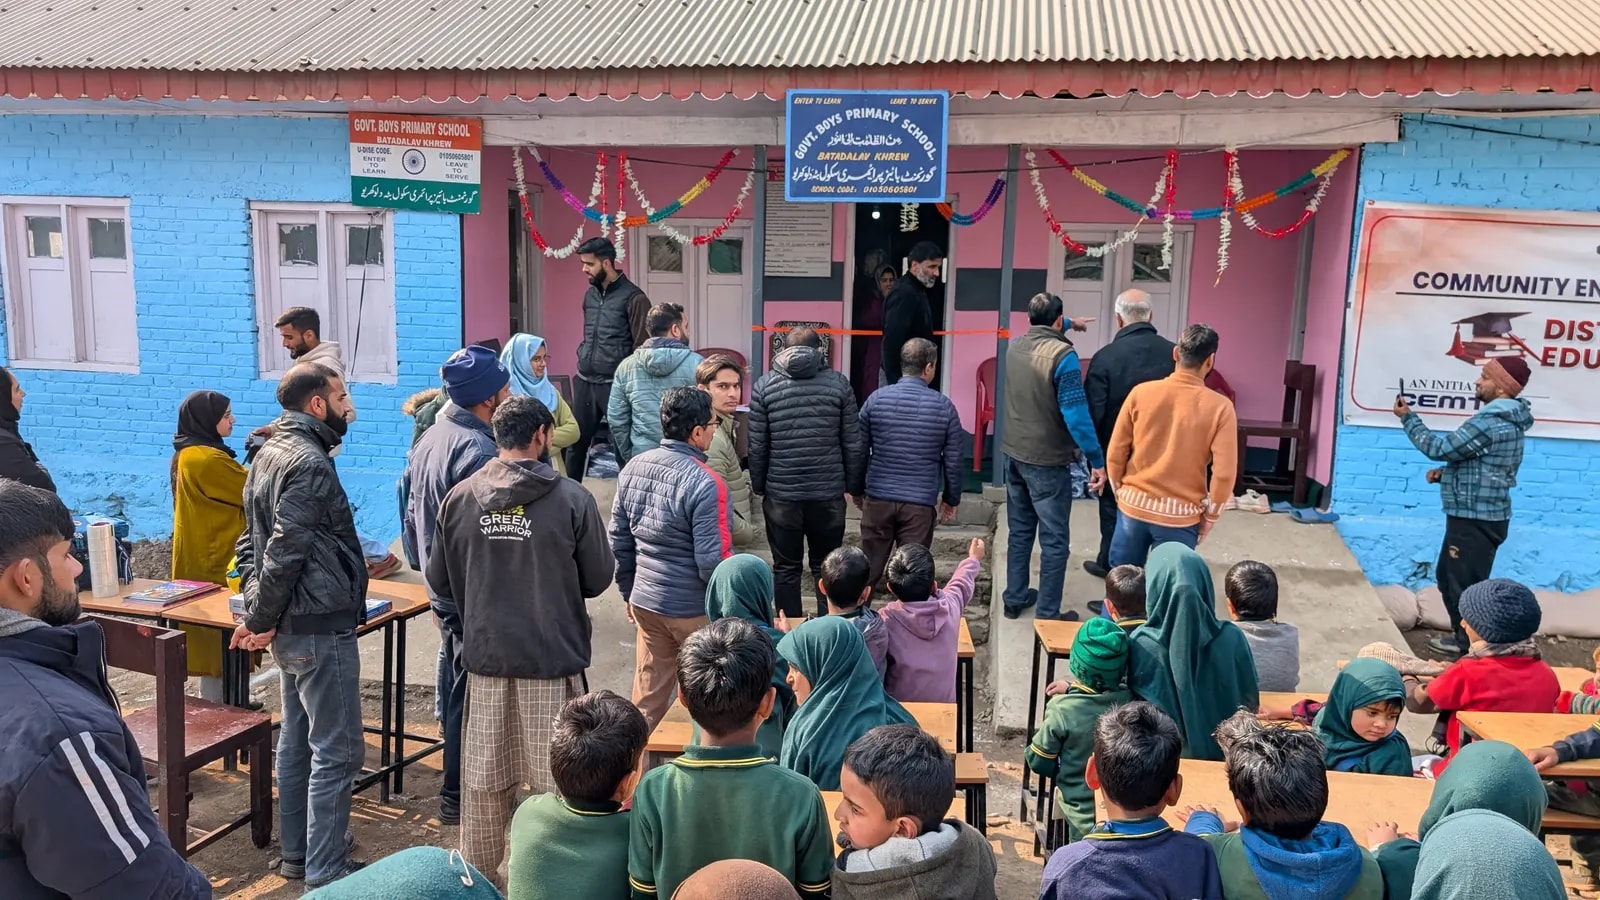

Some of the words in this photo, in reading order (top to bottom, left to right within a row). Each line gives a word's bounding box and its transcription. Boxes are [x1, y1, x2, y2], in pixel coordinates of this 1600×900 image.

[794, 97, 813, 105] ENTER
[815, 97, 823, 105] TO
[823, 97, 842, 105] LEARN
[890, 97, 907, 105] LEAVE
[354, 118, 377, 132] GOVT.
[378, 119, 399, 133] BOYS
[400, 120, 436, 136] PRIMARY
[437, 122, 471, 137] SCHOOL
[794, 131, 819, 160] GOVT.
[815, 112, 843, 135] BOYS
[845, 107, 900, 124] PRIMARY
[376, 136, 422, 147] BATADALAV
[422, 139, 452, 148] KHREW
[357, 146, 375, 154] U-DISE
[375, 147, 392, 155] CODE.
[439, 152, 474, 161] 01050605801
[816, 151, 871, 161] BATADALAV
[874, 152, 910, 161] KHREW
[810, 185, 835, 193] SCHOOL
[836, 185, 857, 193] CODE:
[863, 185, 918, 194] 01050605801
[1413, 271, 1570, 297] COMMUNITY
[1543, 318, 1600, 342] DIS
[1540, 346, 1600, 370] EDU
[1409, 379, 1428, 389] AN
[1431, 380, 1472, 391] INITIA
[1396, 393, 1531, 412] CEMT
[479, 513, 532, 529] GREEN
[479, 524, 532, 538] WARRIOR
